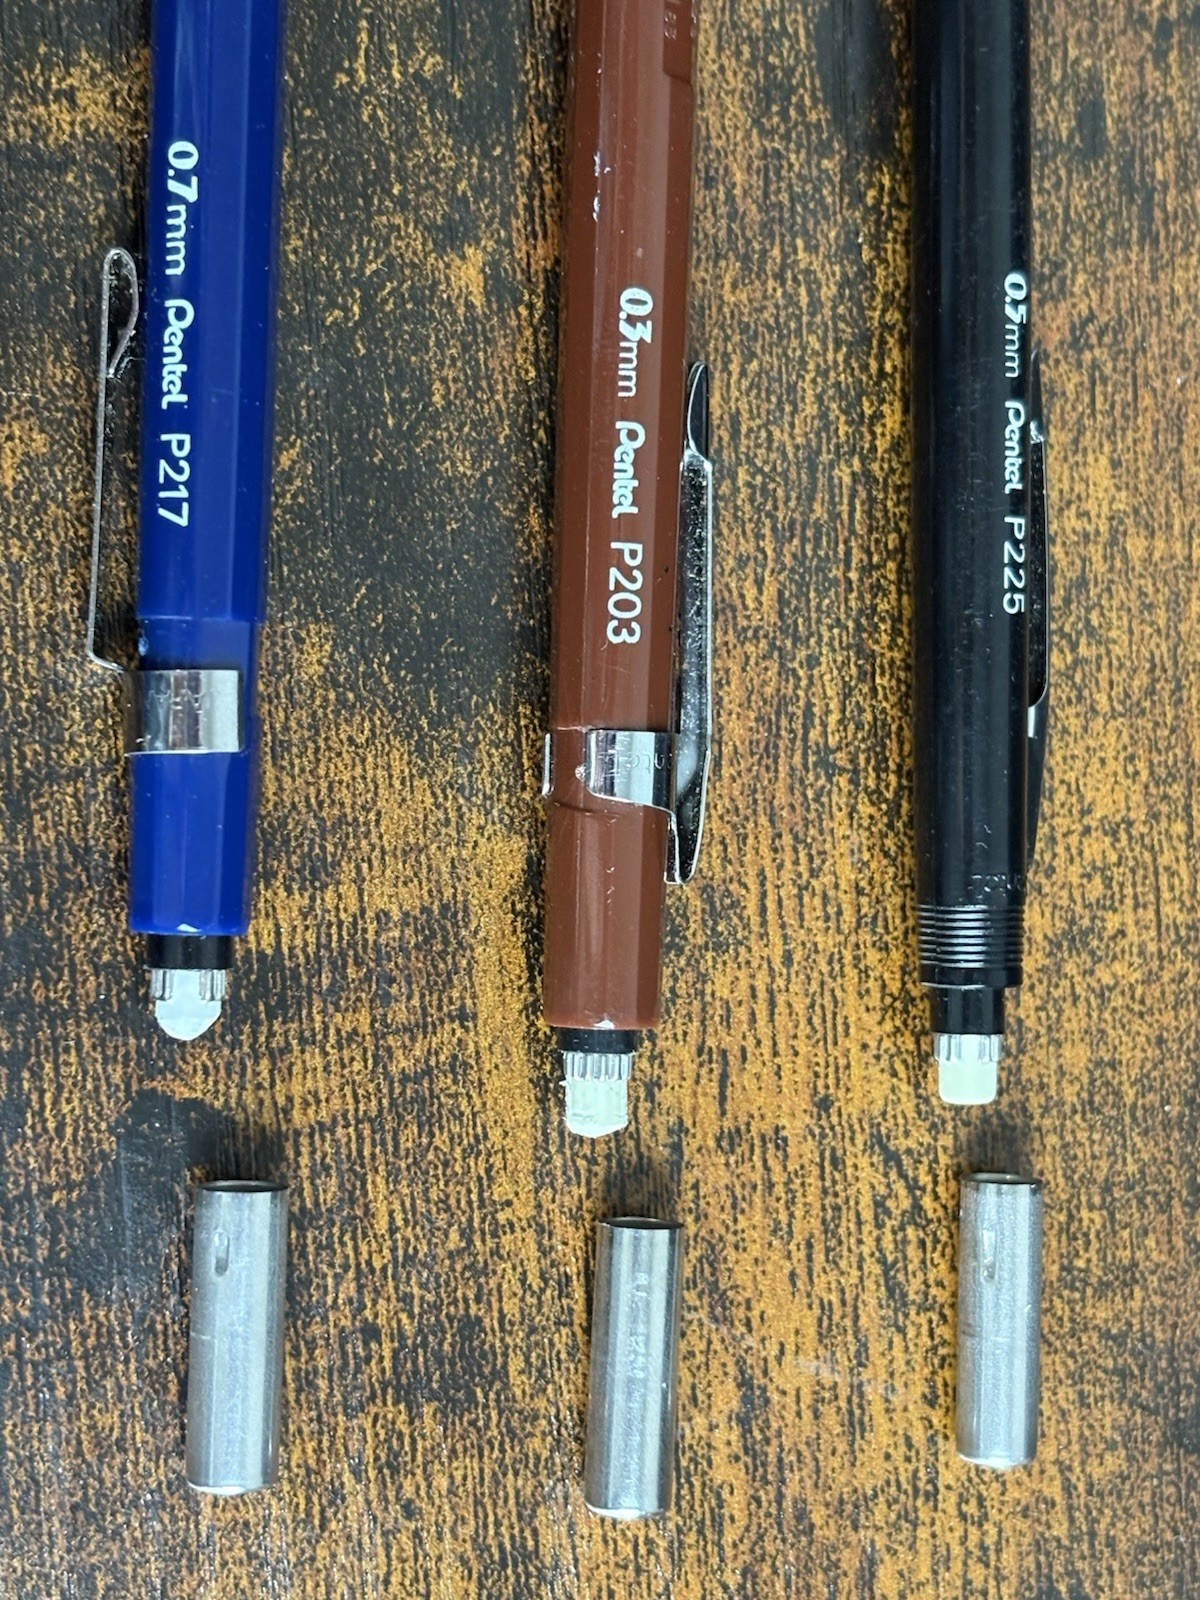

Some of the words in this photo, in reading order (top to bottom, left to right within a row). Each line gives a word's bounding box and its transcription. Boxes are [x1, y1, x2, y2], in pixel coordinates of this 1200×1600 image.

[161, 298, 195, 410] Pentel
[617, 286, 654, 398] 0.3mm
[1002, 271, 1029, 379] 0.5mm
[157, 433, 191, 527] P217
[611, 420, 646, 519] Pentel
[1003, 399, 1028, 493] Pentel
[605, 541, 644, 646] P203
[1001, 515, 1027, 616] P225
